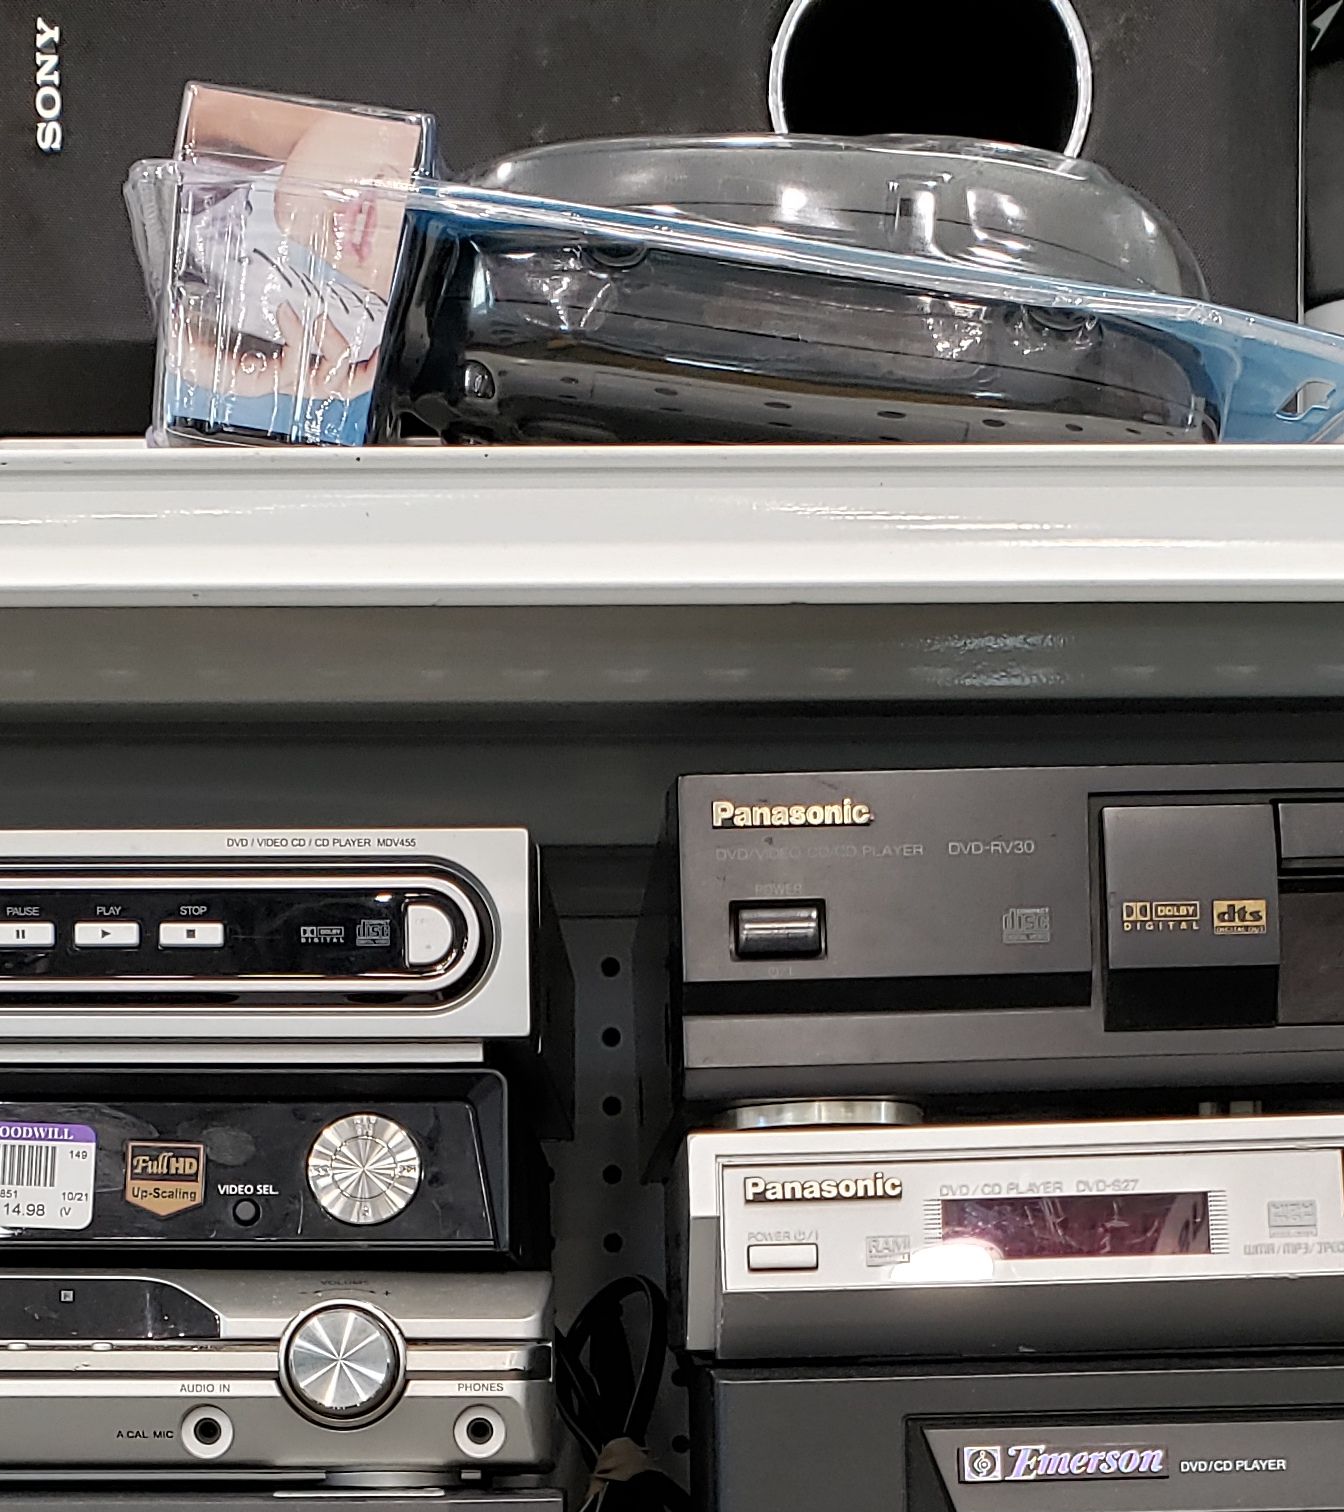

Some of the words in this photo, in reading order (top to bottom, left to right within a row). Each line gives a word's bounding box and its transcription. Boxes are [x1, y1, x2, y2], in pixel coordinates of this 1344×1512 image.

[35, 17, 60, 152] SONY
[713, 798, 872, 827] Panasonic
[226, 838, 248, 848] DVD
[257, 838, 289, 848] VIDEO
[332, 837, 371, 848] PLAYER
[377, 837, 416, 848] MDV455
[862, 844, 923, 857] PLAYER
[948, 841, 1035, 855] DVD-RV30
[6, 906, 40, 916] PAUSE
[96, 906, 122, 916] PLAY
[179, 905, 207, 916] STOP
[1123, 921, 1199, 931] DIGITAL
[68, 1149, 88, 1160] 149
[217, 1184, 253, 1195] VIDEO
[256, 1184, 278, 1195] SEL.
[744, 1173, 901, 1200] Panasonic
[1006, 1181, 1063, 1195] PLAYER
[1076, 1179, 1138, 1193] DVD-S27
[61, 1190, 89, 1203] 10/21
[132, 1185, 197, 1202] Up-Scaling
[3, 1202, 46, 1218] 14.98
[180, 1384, 215, 1393] AUDIO
[219, 1383, 230, 1393] IN
[457, 1383, 504, 1393] PHONES
[153, 1430, 174, 1439] MIC
[1005, 1445, 1164, 1480] Emerson
[1180, 1460, 1232, 1473] DVD/CD
[1235, 1459, 1286, 1472] PLAYER
